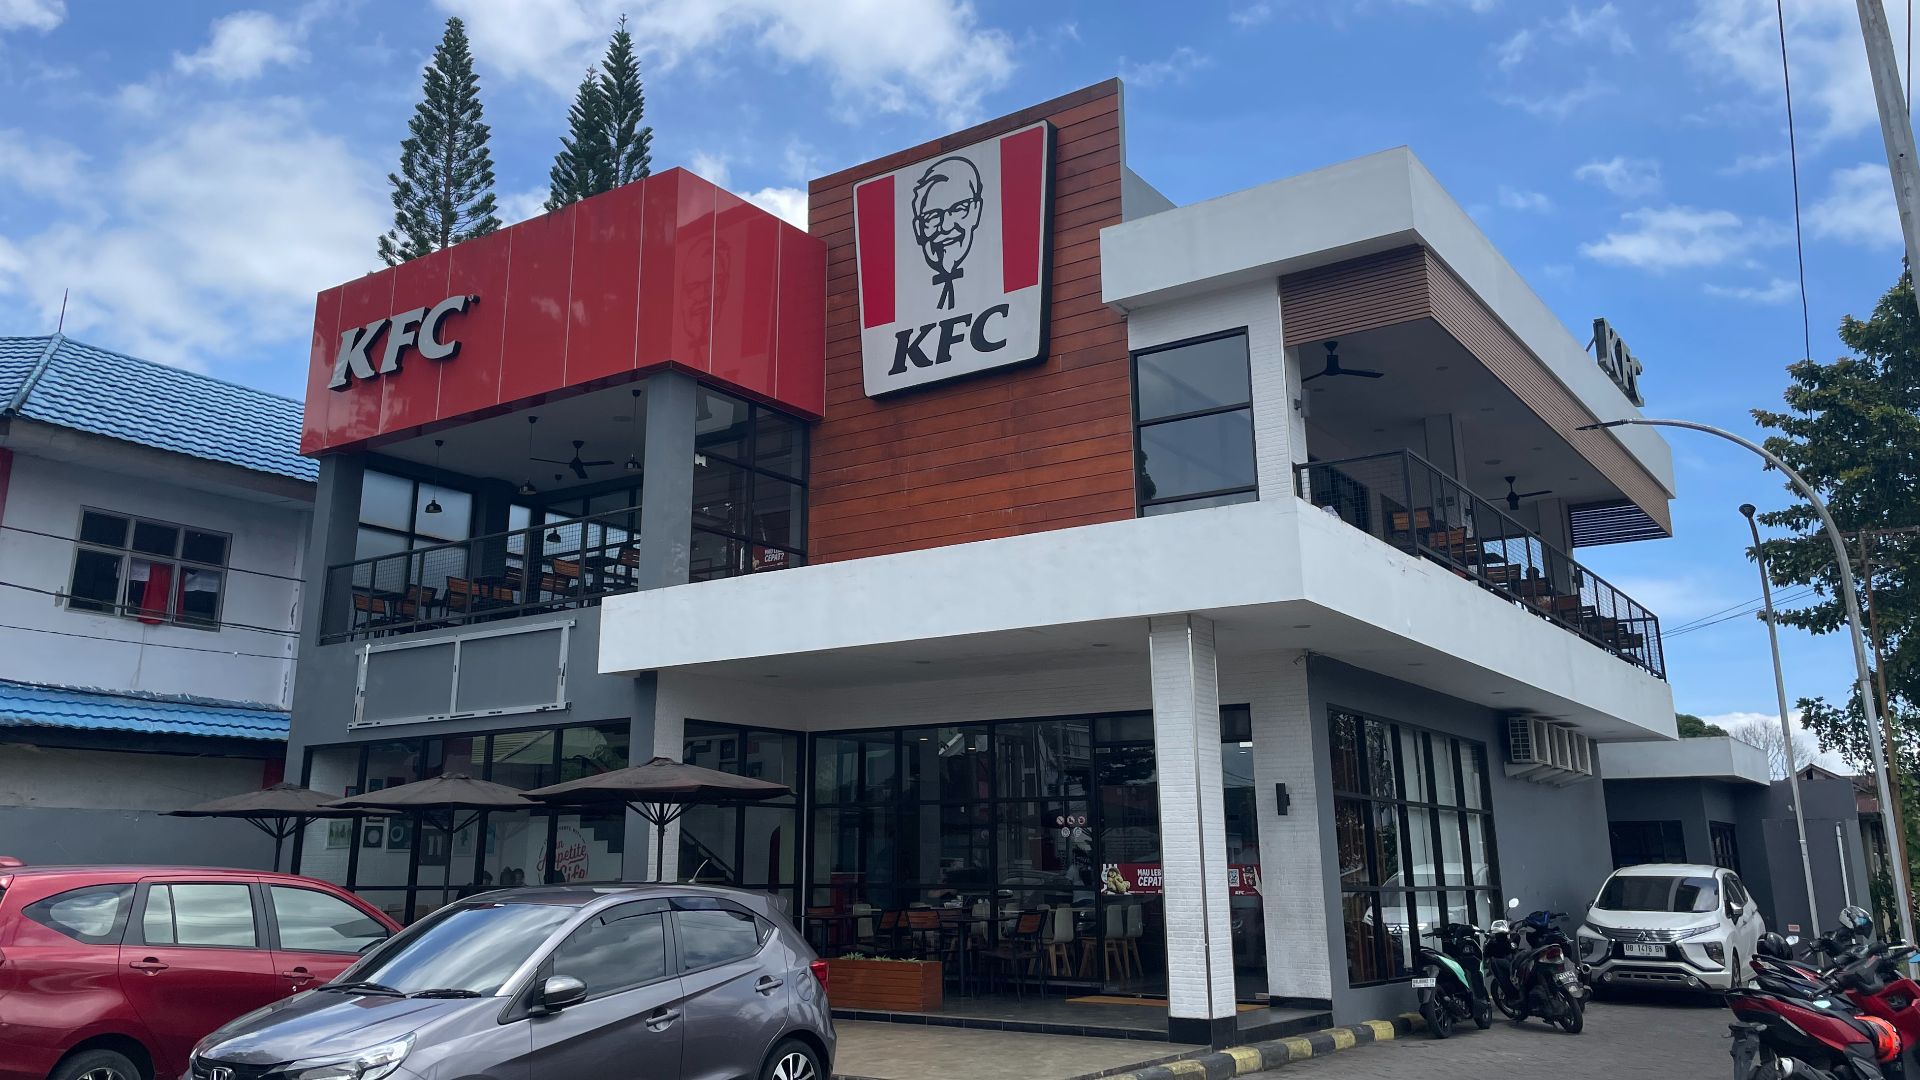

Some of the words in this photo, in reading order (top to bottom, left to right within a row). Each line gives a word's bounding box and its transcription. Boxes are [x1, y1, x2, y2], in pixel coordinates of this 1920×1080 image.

[328, 296, 467, 390] KFC
[888, 303, 1010, 376] KFC
[1137, 868, 1150, 877] MAU
